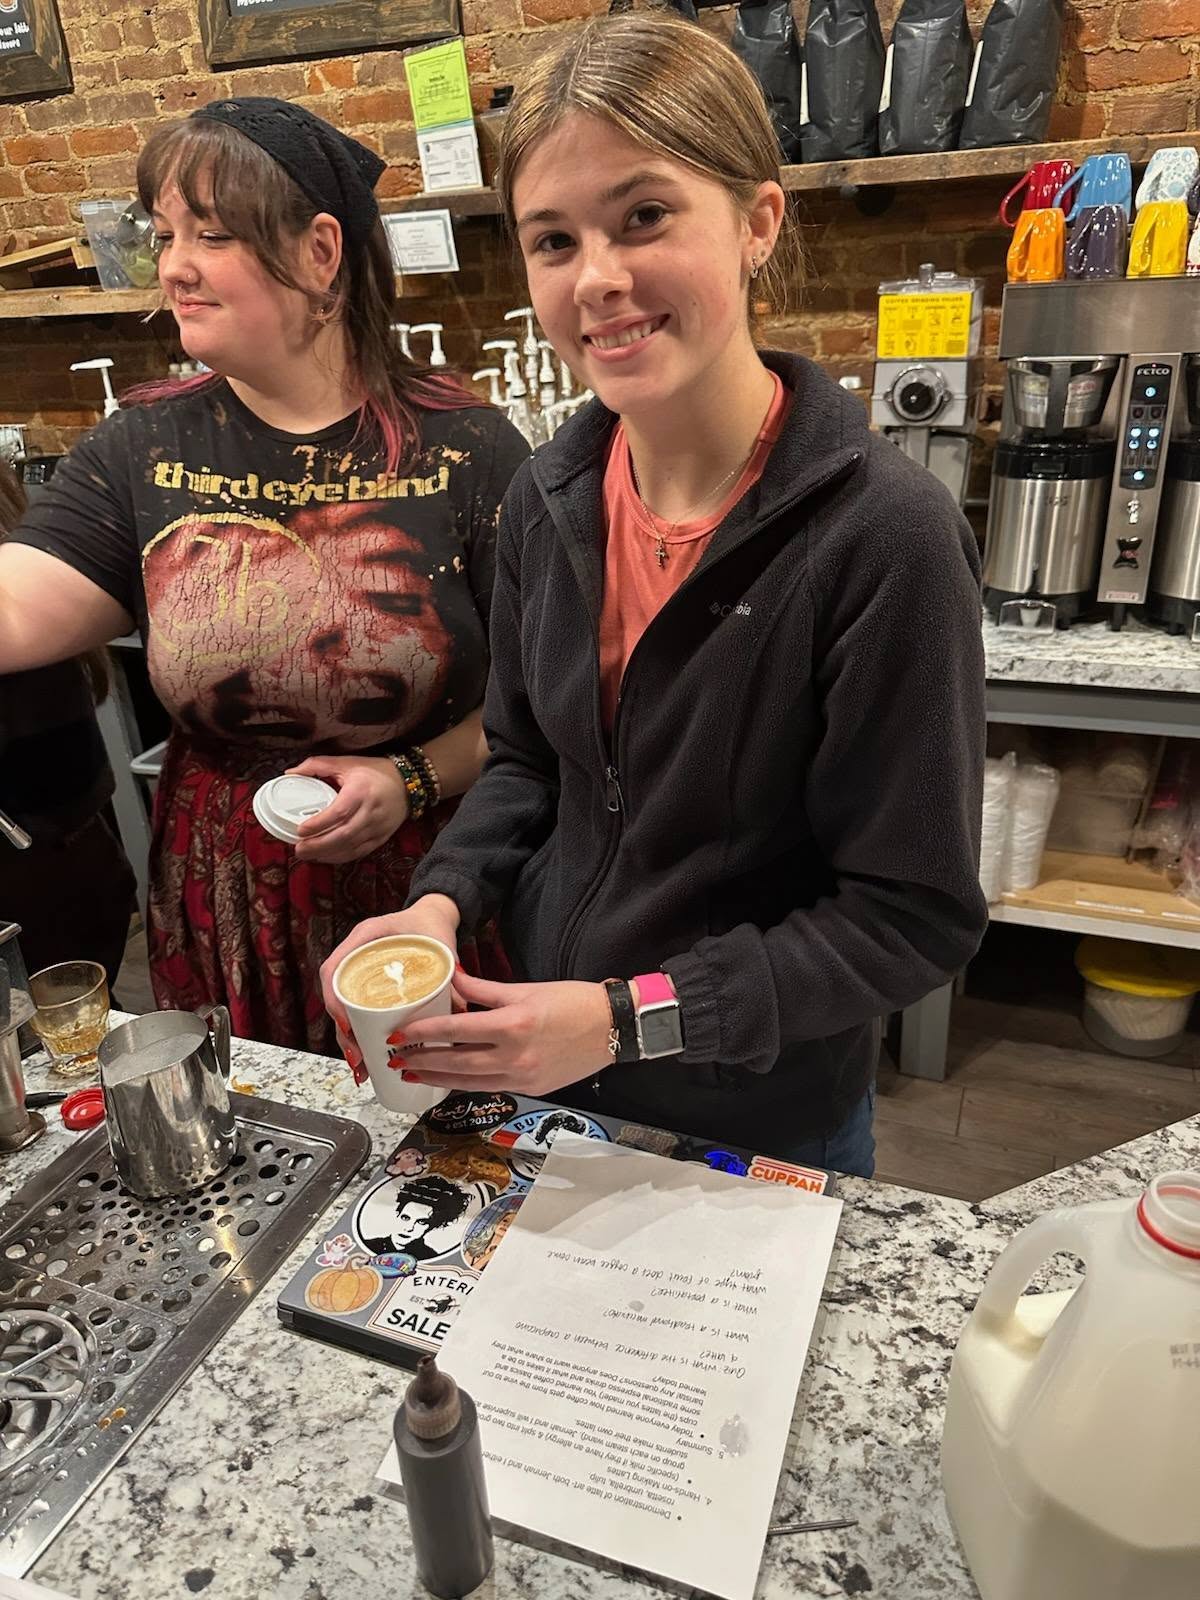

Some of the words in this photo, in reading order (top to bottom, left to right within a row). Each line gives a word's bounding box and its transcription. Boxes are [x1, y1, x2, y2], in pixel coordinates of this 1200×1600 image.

[751, 1166, 822, 1193] CUPPAH
[413, 1276, 474, 1296] ENTERI
[387, 1308, 451, 1341] SALE
[490, 1339, 506, 1350] they
[506, 1345, 524, 1355] what
[506, 1355, 517, 1363] be
[524, 1351, 545, 1361] share
[544, 1356, 553, 1364] to
[493, 1362, 509, 1371] and
[516, 1358, 525, 1366] to
[525, 1361, 545, 1372] takes
[553, 1359, 571, 1368] want
[509, 1366, 532, 1378] basics
[550, 1368, 569, 1377] what
[571, 1363, 598, 1375] anyone
[494, 1372, 502, 1380] to
[502, 1375, 518, 1384] vine
[532, 1374, 555, 1384] coffee
[568, 1373, 584, 1382] and
[598, 1370, 618, 1381] Does
[652, 1375, 677, 1387] today?
[518, 1379, 531, 1389] the
[554, 1379, 582, 1393] learned
[584, 1377, 607, 1388] drinks
[618, 1377, 659, 1392] questions?
[531, 1384, 548, 1394] from
[548, 1388, 565, 1398] gets
[582, 1387, 597, 1397] You
[607, 1383, 641, 1398] espresso
[659, 1386, 675, 1397] Any
[677, 1382, 706, 1396] learned
[565, 1393, 588, 1404] coffee
[625, 1399, 640, 1408] you
[641, 1393, 678, 1409] traditional
[675, 1392, 703, 1406] barista!
[481, 1403, 516, 1417] supervise
[588, 1400, 605, 1409] how
[640, 1404, 661, 1416] lattes
[679, 1404, 700, 1415] some
[605, 1405, 633, 1420] learned
[662, 1410, 678, 1421] (the
[491, 1417, 505, 1427] two
[505, 1421, 520, 1431] into
[533, 1418, 549, 1427] and
[634, 1414, 670, 1429] everyone
[678, 1415, 698, 1426] cups
[520, 1426, 536, 1436] split
[549, 1423, 577, 1437] Jennah
[596, 1426, 613, 1436] own
[670, 1424, 693, 1438] Today
[544, 1432, 572, 1447] allergy)
[613, 1431, 631, 1442] their
[632, 1436, 654, 1448] make
[573, 1443, 584, 1451] an
[604, 1440, 628, 1452] steam
[655, 1443, 688, 1459] students
[675, 1437, 713, 1455] Summary
[584, 1446, 604, 1459] have
[604, 1451, 622, 1464] they
[629, 1448, 649, 1459] each
[649, 1454, 661, 1462] on
[506, 1459, 523, 1469] and
[629, 1459, 645, 1470] milk
[661, 1457, 685, 1470] group
[523, 1464, 551, 1479] Jennah
[606, 1465, 631, 1479] Lattes
[646, 1465, 679, 1481] (specific
[552, 1474, 570, 1486] both
[631, 1471, 660, 1488] Making
[585, 1485, 603, 1497] latte
[602, 1491, 613, 1499] of
[661, 1483, 700, 1501] Hands-on
[613, 1495, 671, 1519] Demonstration
